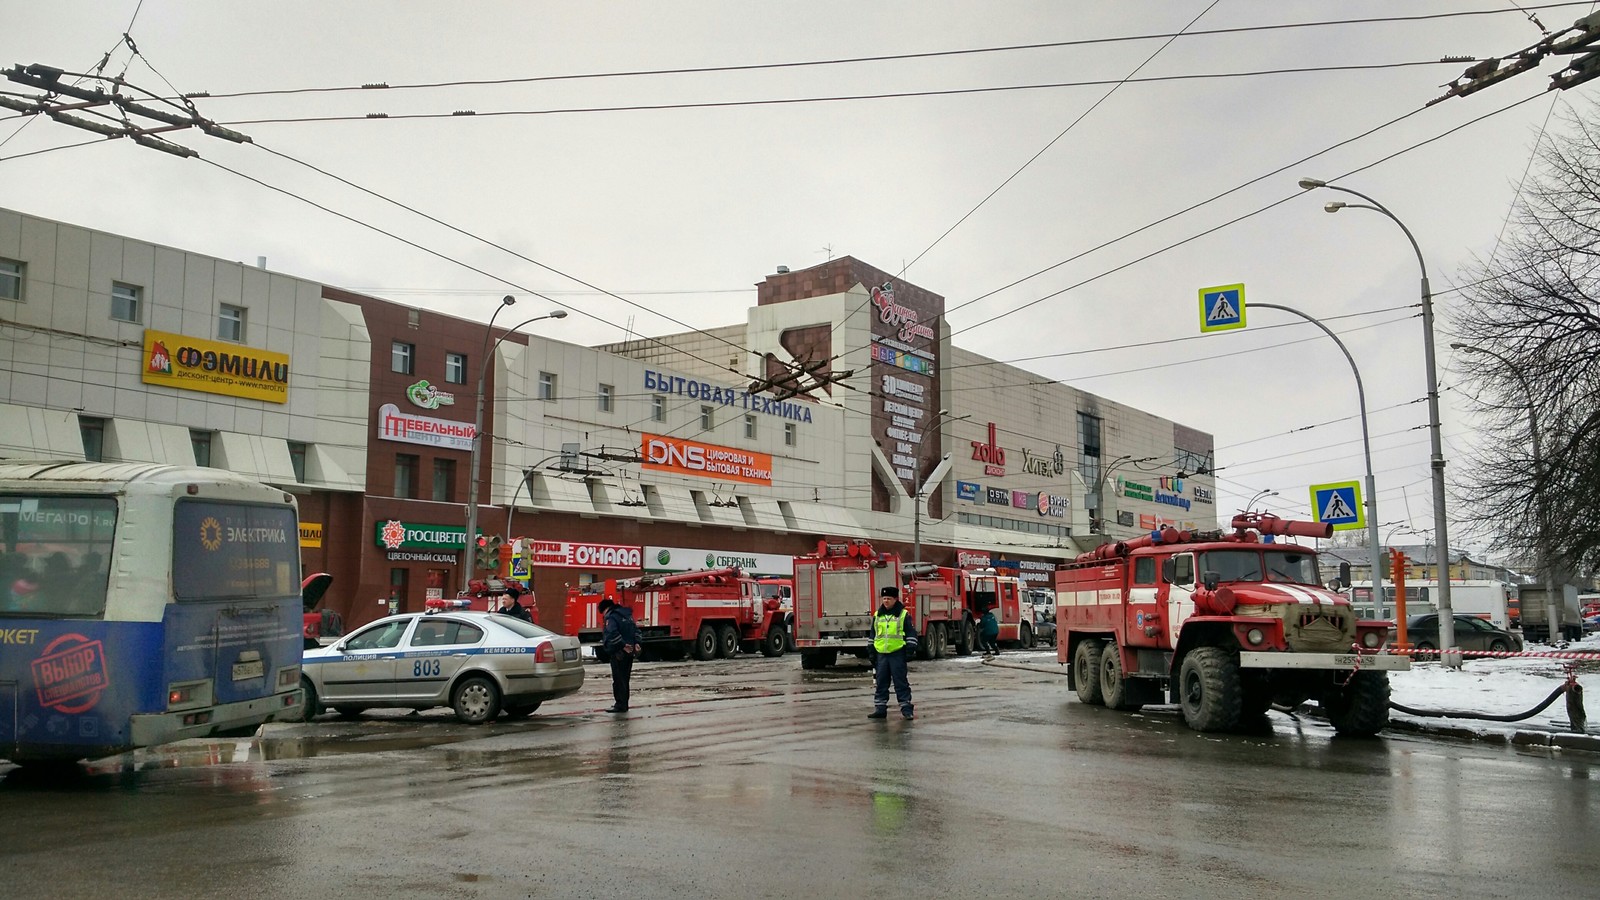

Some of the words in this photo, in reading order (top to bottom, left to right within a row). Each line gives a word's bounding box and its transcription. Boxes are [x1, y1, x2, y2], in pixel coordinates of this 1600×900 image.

[644, 369, 734, 407] БЫТОВАЯ
[741, 390, 812, 424] ТЕХНИКА
[648, 440, 705, 470] DNS
[706, 448, 746, 465] ЦИФРОВАЯ
[748, 456, 754, 466] И
[706, 462, 740, 475] БЫТОВАЯ
[742, 468, 772, 481] ТЕХНИКА
[388, 551, 431, 562] ЦВЕТОЧНЫЙ
[432, 553, 457, 565] СКЛАД
[576, 545, 640, 566] O'HARA
[716, 555, 757, 569] СБЕРБАНК
[343, 653, 378, 662] ПОЛИЦИЯ
[484, 646, 527, 654] КЕМЕРОВО
[413, 659, 441, 677] 803
